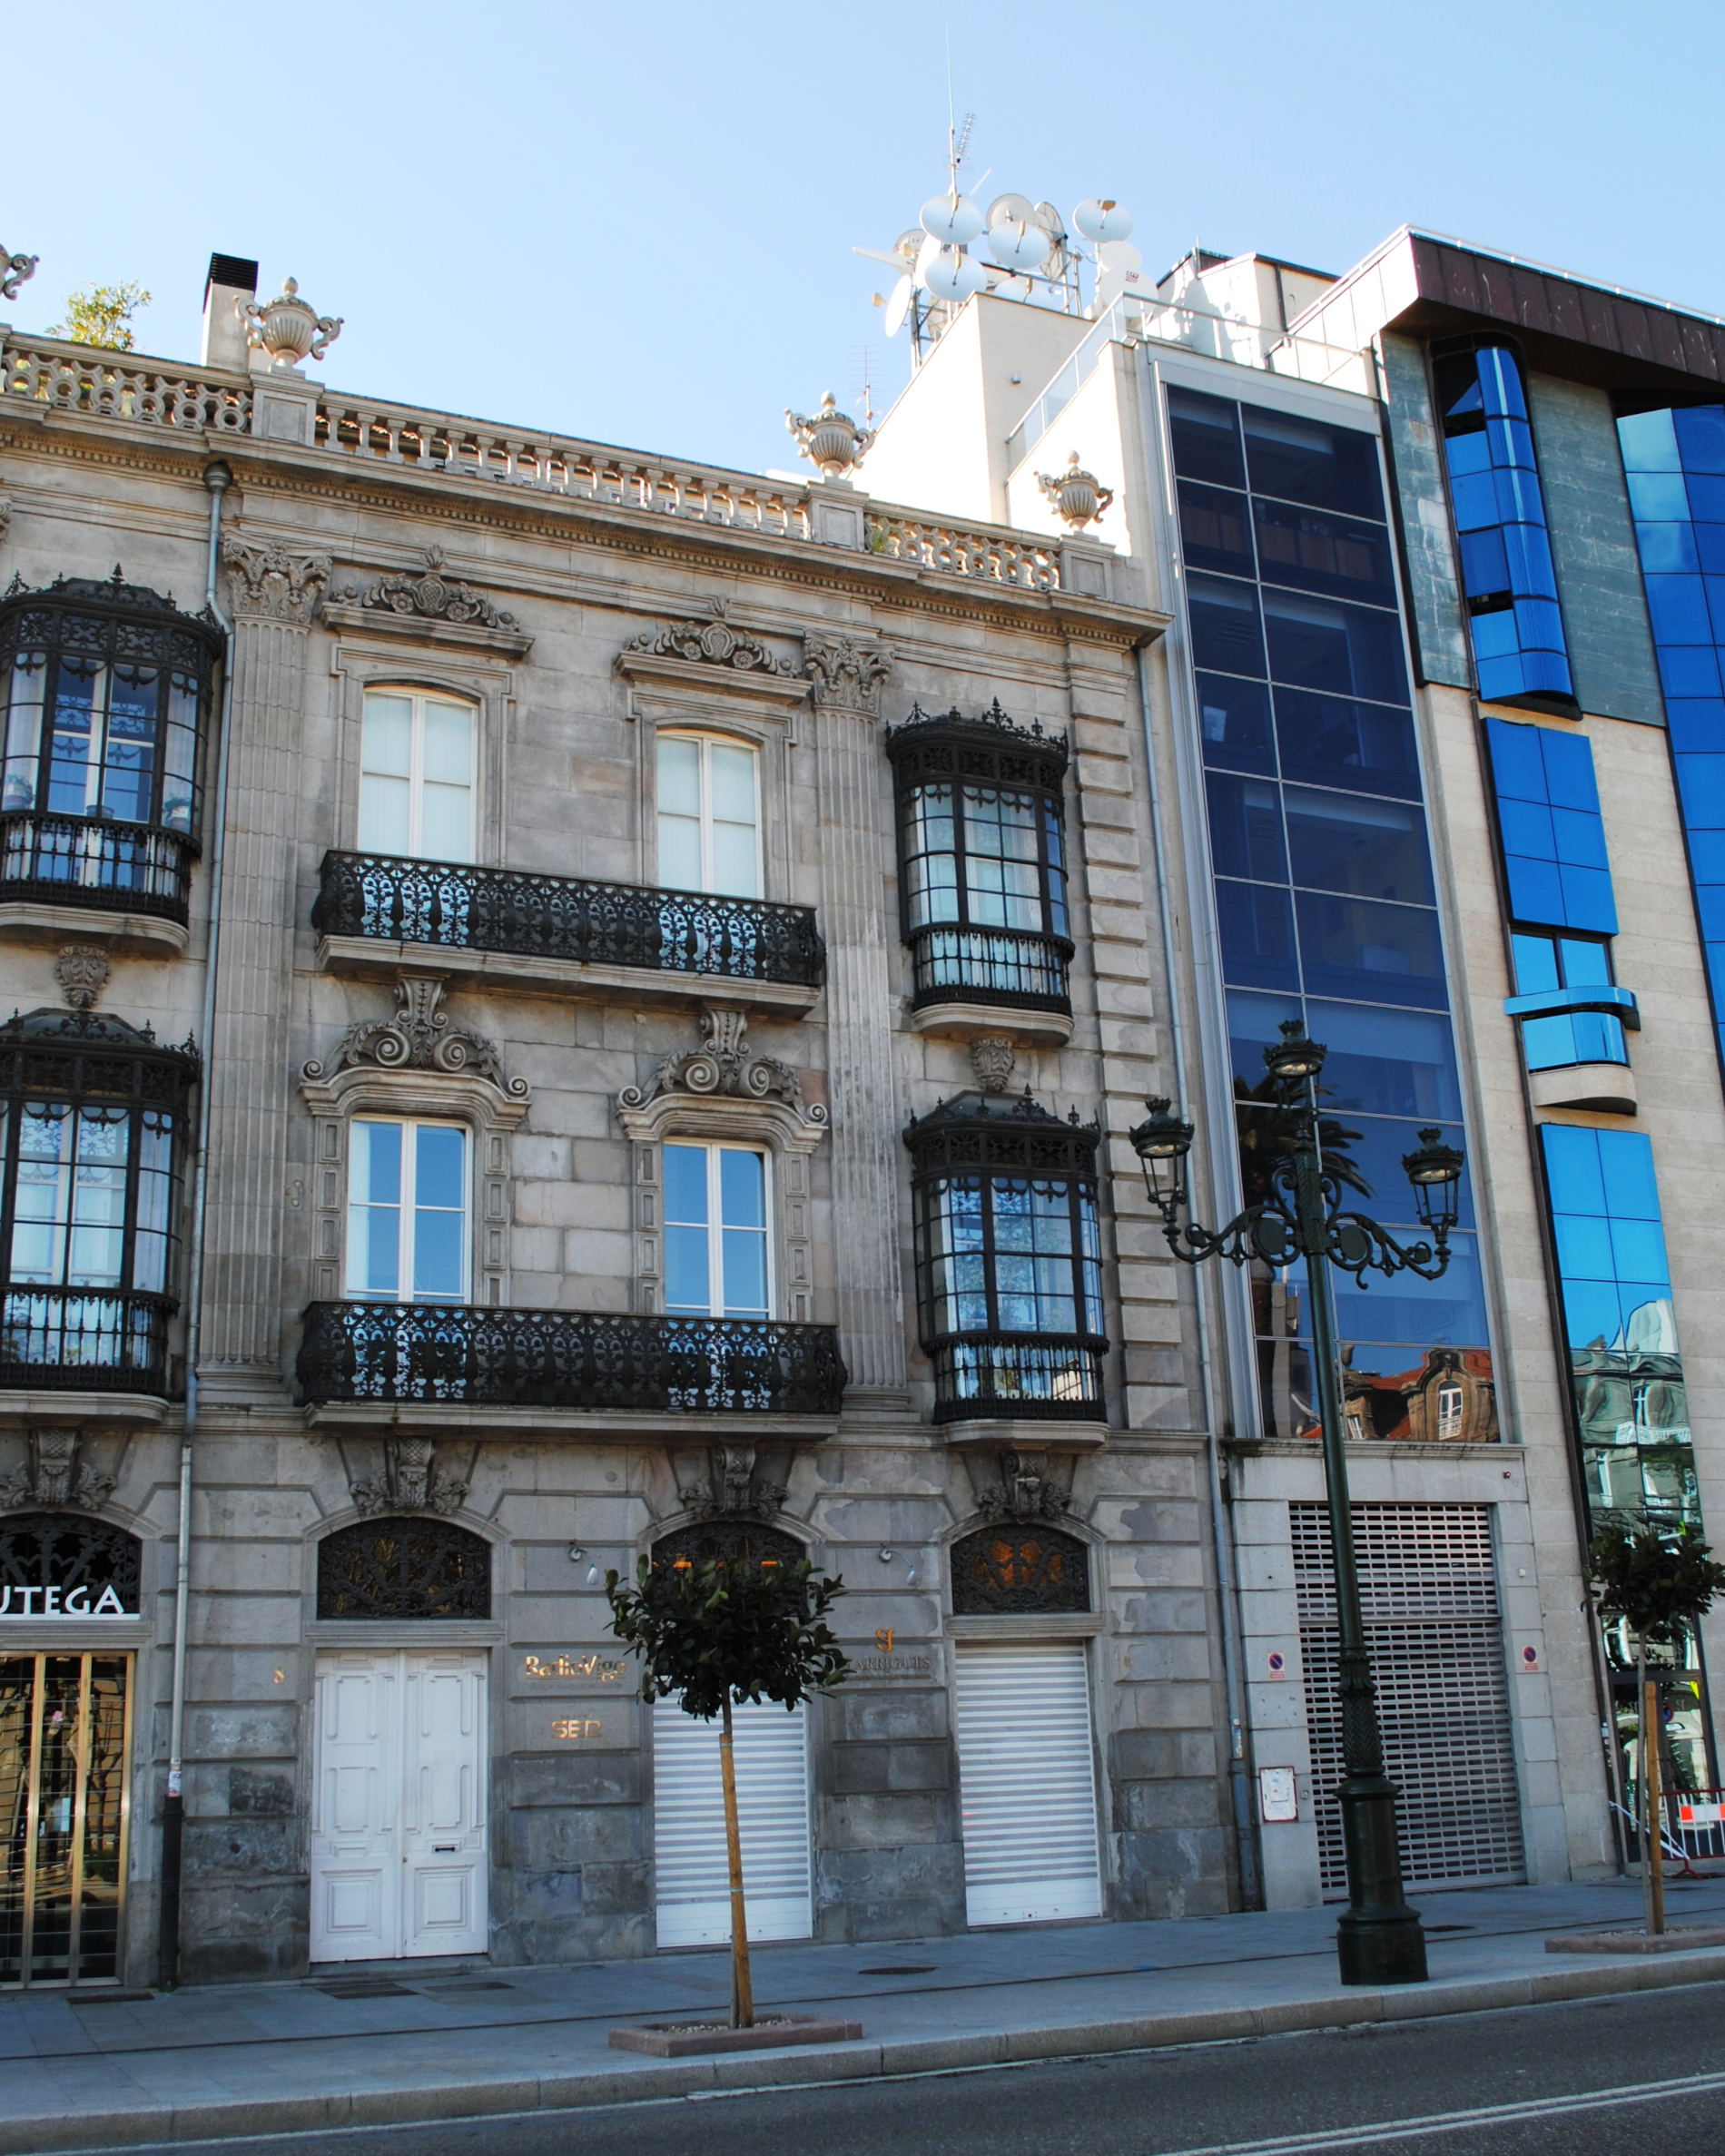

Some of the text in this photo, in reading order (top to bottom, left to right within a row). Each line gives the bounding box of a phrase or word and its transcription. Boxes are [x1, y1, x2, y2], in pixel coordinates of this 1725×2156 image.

[526, 1654, 626, 1682] RadioVigo
[847, 1656, 932, 1669] ARRIGUES
[551, 1719, 602, 1739] SER
